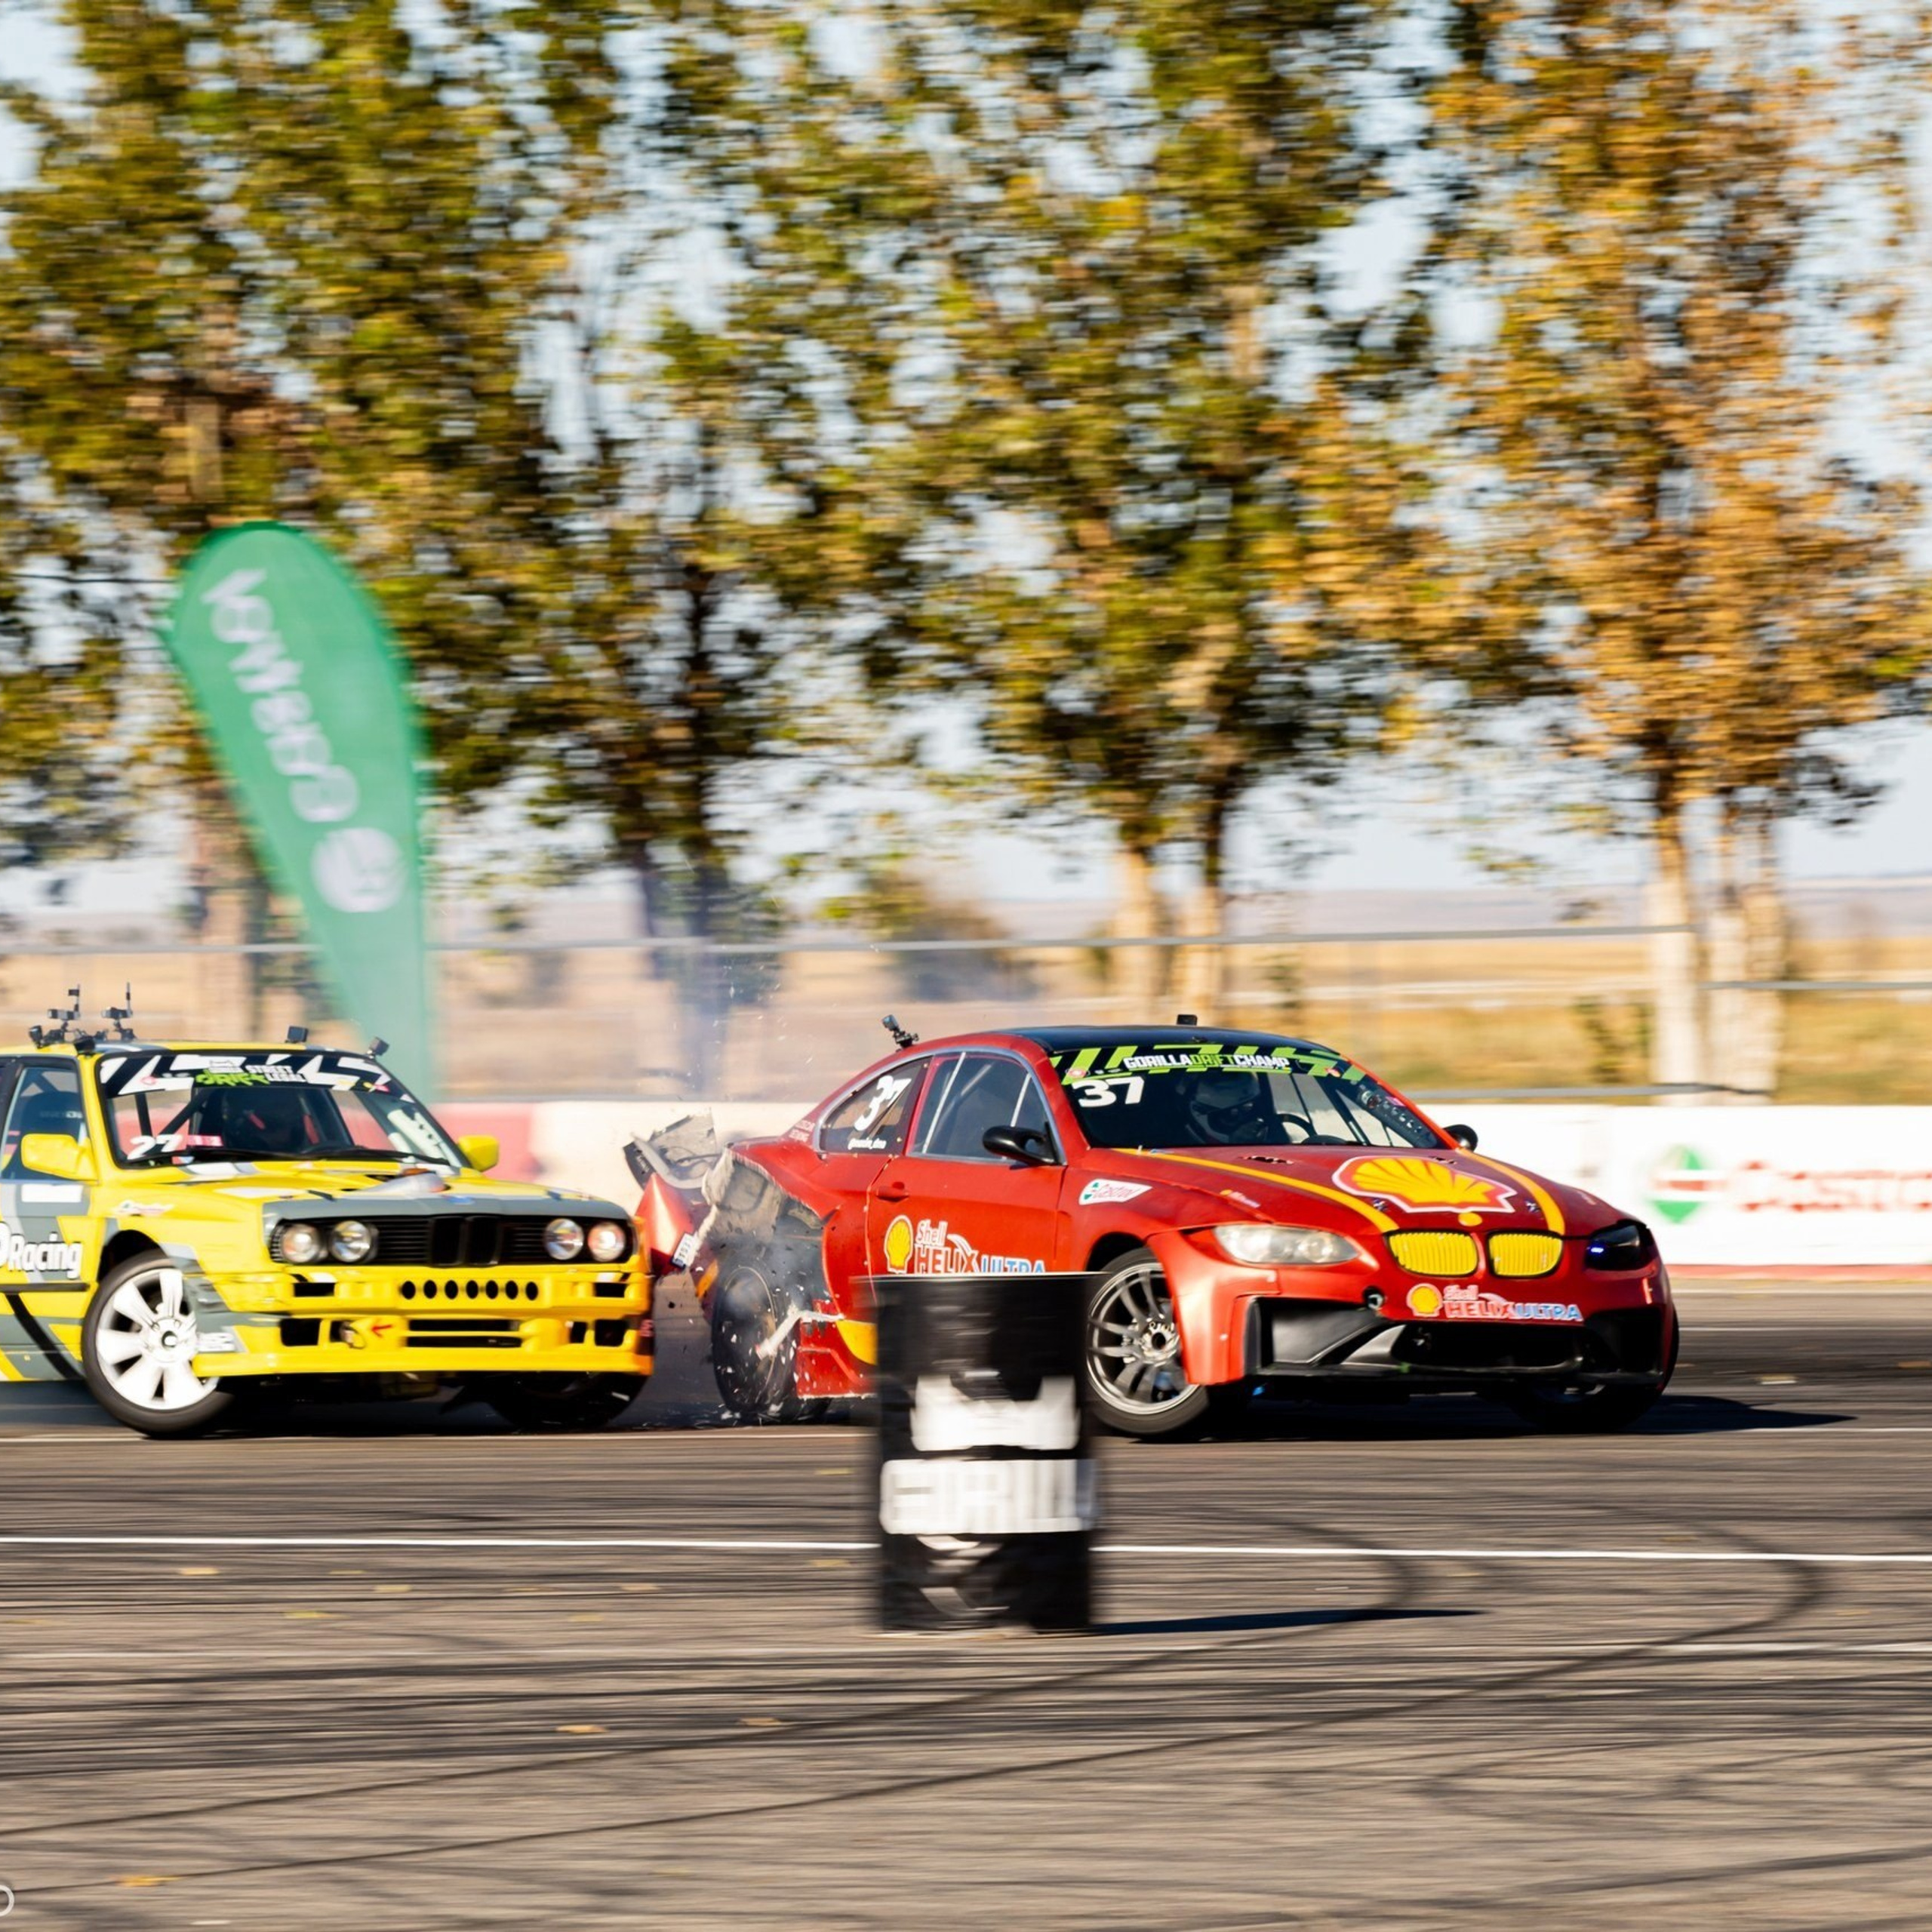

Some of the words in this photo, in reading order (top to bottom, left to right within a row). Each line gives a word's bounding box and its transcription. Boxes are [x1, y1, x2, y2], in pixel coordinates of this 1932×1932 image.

[854, 1075, 912, 1131] 37
[1071, 1076, 1145, 1108] 37
[127, 1134, 183, 1160] 27
[915, 1219, 948, 1247] Shell
[8, 1231, 83, 1280] Racing
[914, 1242, 979, 1274] HELIX
[1443, 1284, 1480, 1300] Shell
[1442, 1300, 1515, 1319] HELIX
[1515, 1303, 1583, 1321] ULTRA
